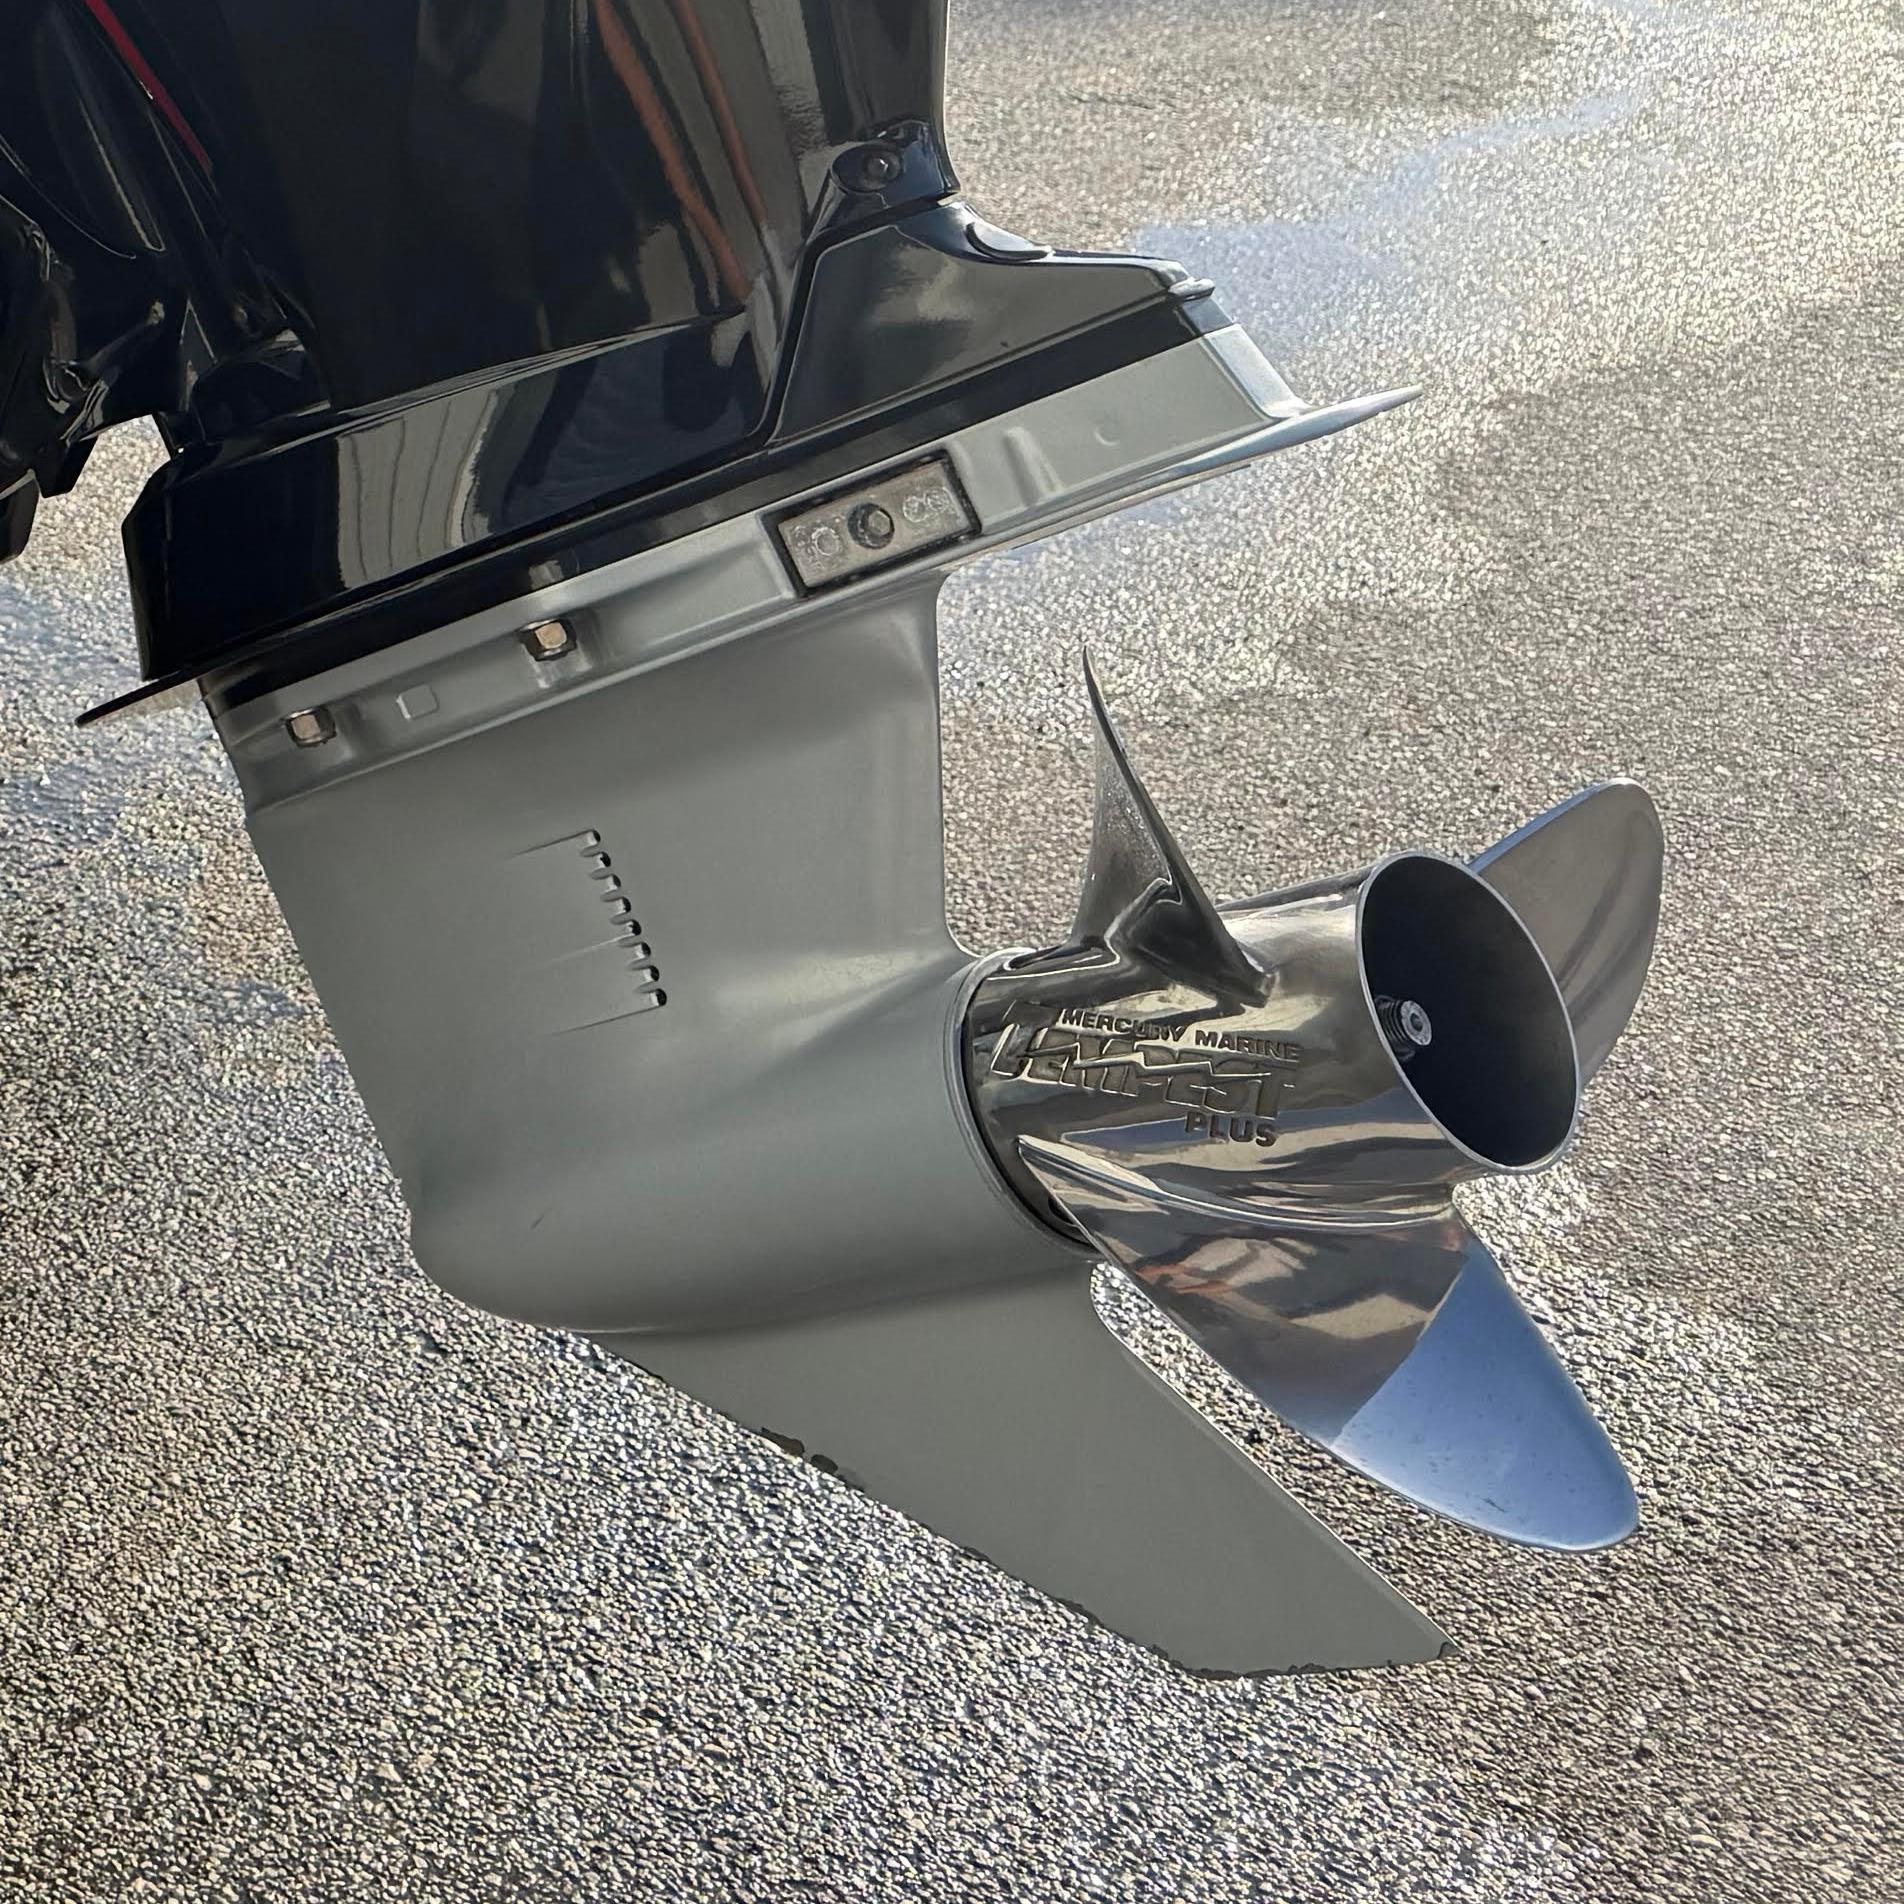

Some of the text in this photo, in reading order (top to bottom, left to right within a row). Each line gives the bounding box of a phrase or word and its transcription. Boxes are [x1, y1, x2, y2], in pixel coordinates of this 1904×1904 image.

[1061, 1008, 1302, 1062] MERCURY MARINE
[1185, 1111, 1277, 1147] PLUS
